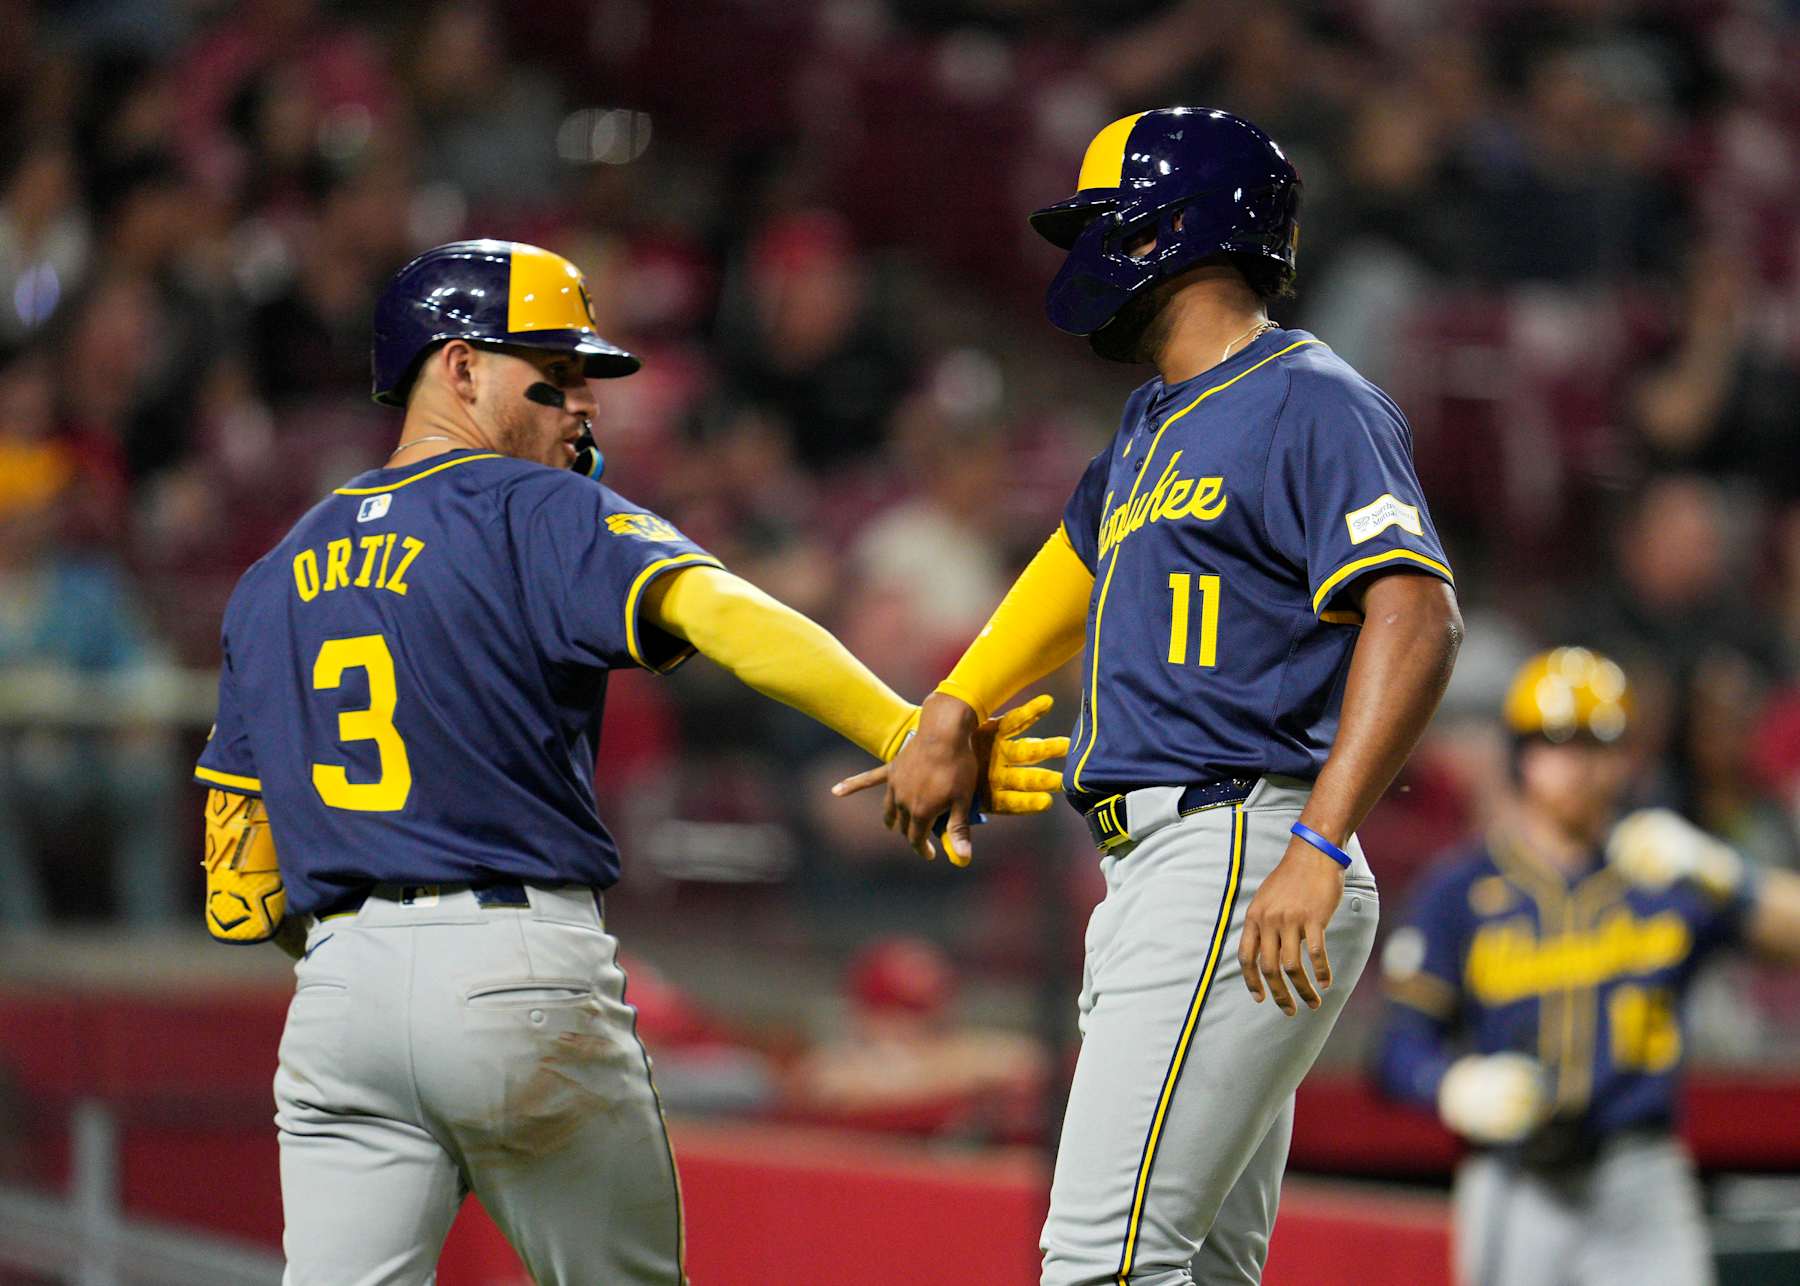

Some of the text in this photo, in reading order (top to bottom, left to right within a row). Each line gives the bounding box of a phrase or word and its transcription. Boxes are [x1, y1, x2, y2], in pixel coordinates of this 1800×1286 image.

[293, 533, 425, 602] ORTIZ
[1168, 573, 1220, 667] 11
[312, 635, 412, 812] 3
